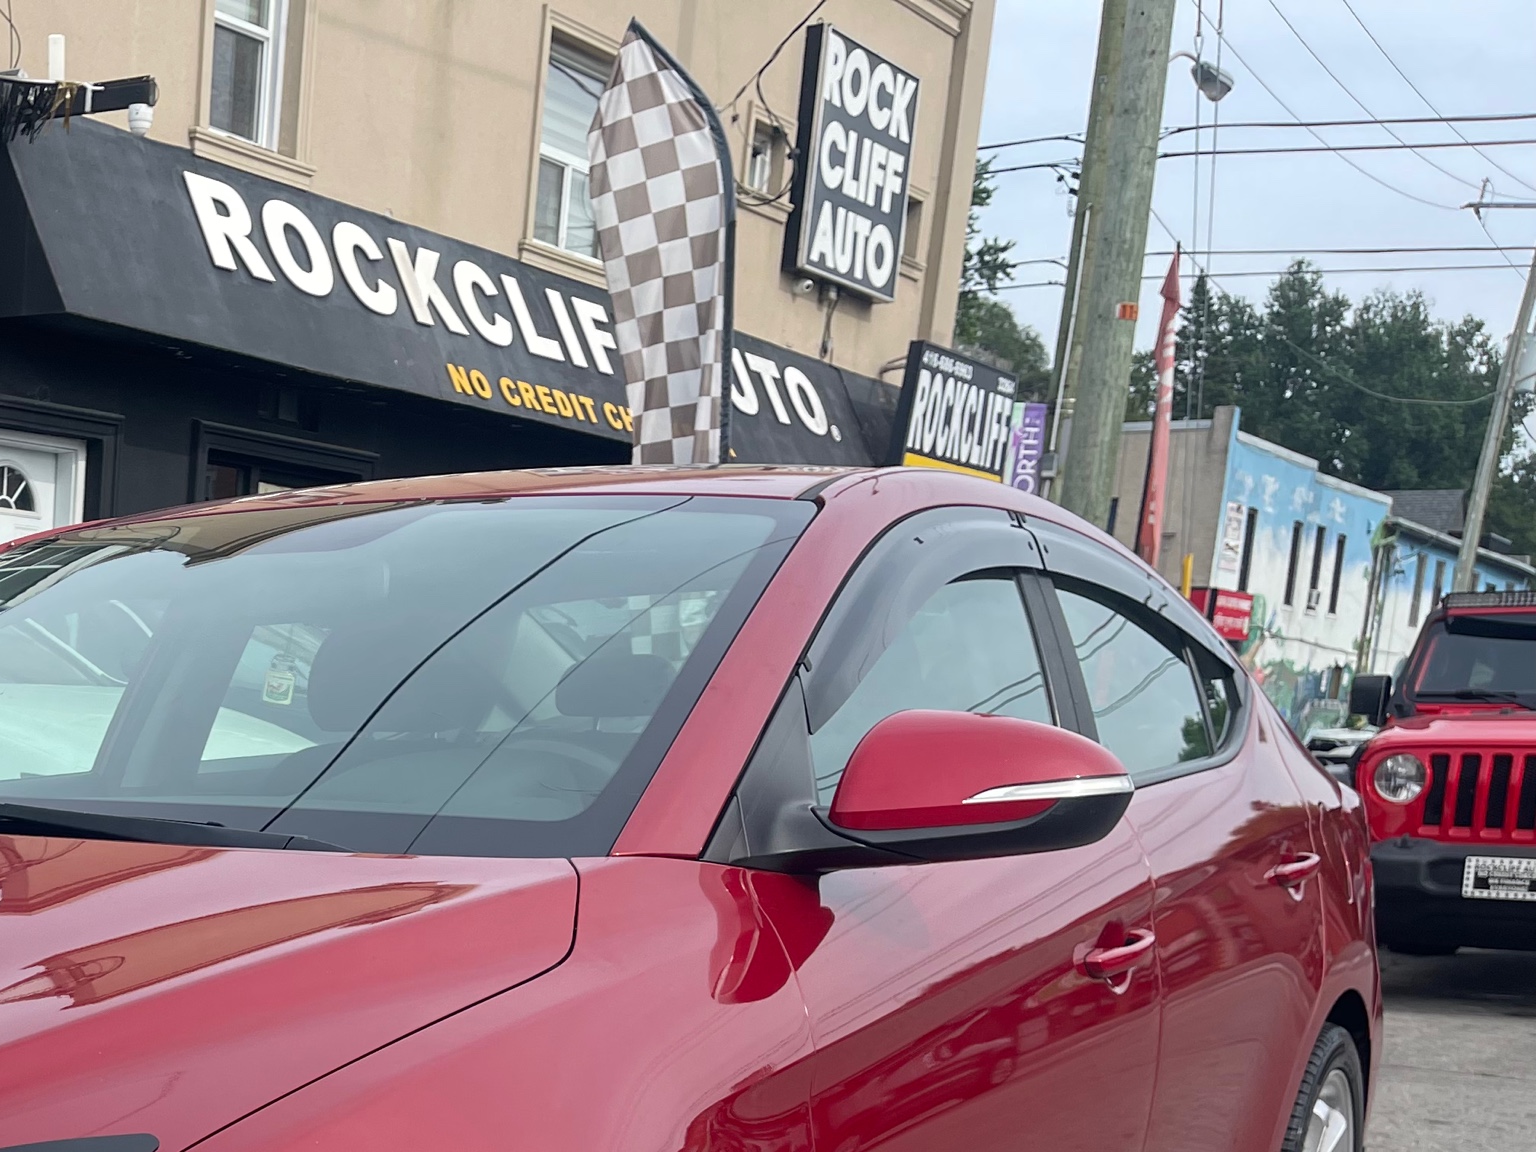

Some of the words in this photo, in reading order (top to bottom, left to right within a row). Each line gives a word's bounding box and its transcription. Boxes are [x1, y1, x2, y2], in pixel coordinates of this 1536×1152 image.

[823, 32, 917, 144] ROCK
[819, 121, 905, 214] CLIFF
[809, 200, 894, 289] AUTO
[182, 170, 617, 375] ROCKCLIF
[731, 347, 842, 443] UTO.
[447, 363, 492, 400] NO
[500, 376, 598, 423] CREDIT
[906, 368, 1013, 471] ROCKCLIFF
